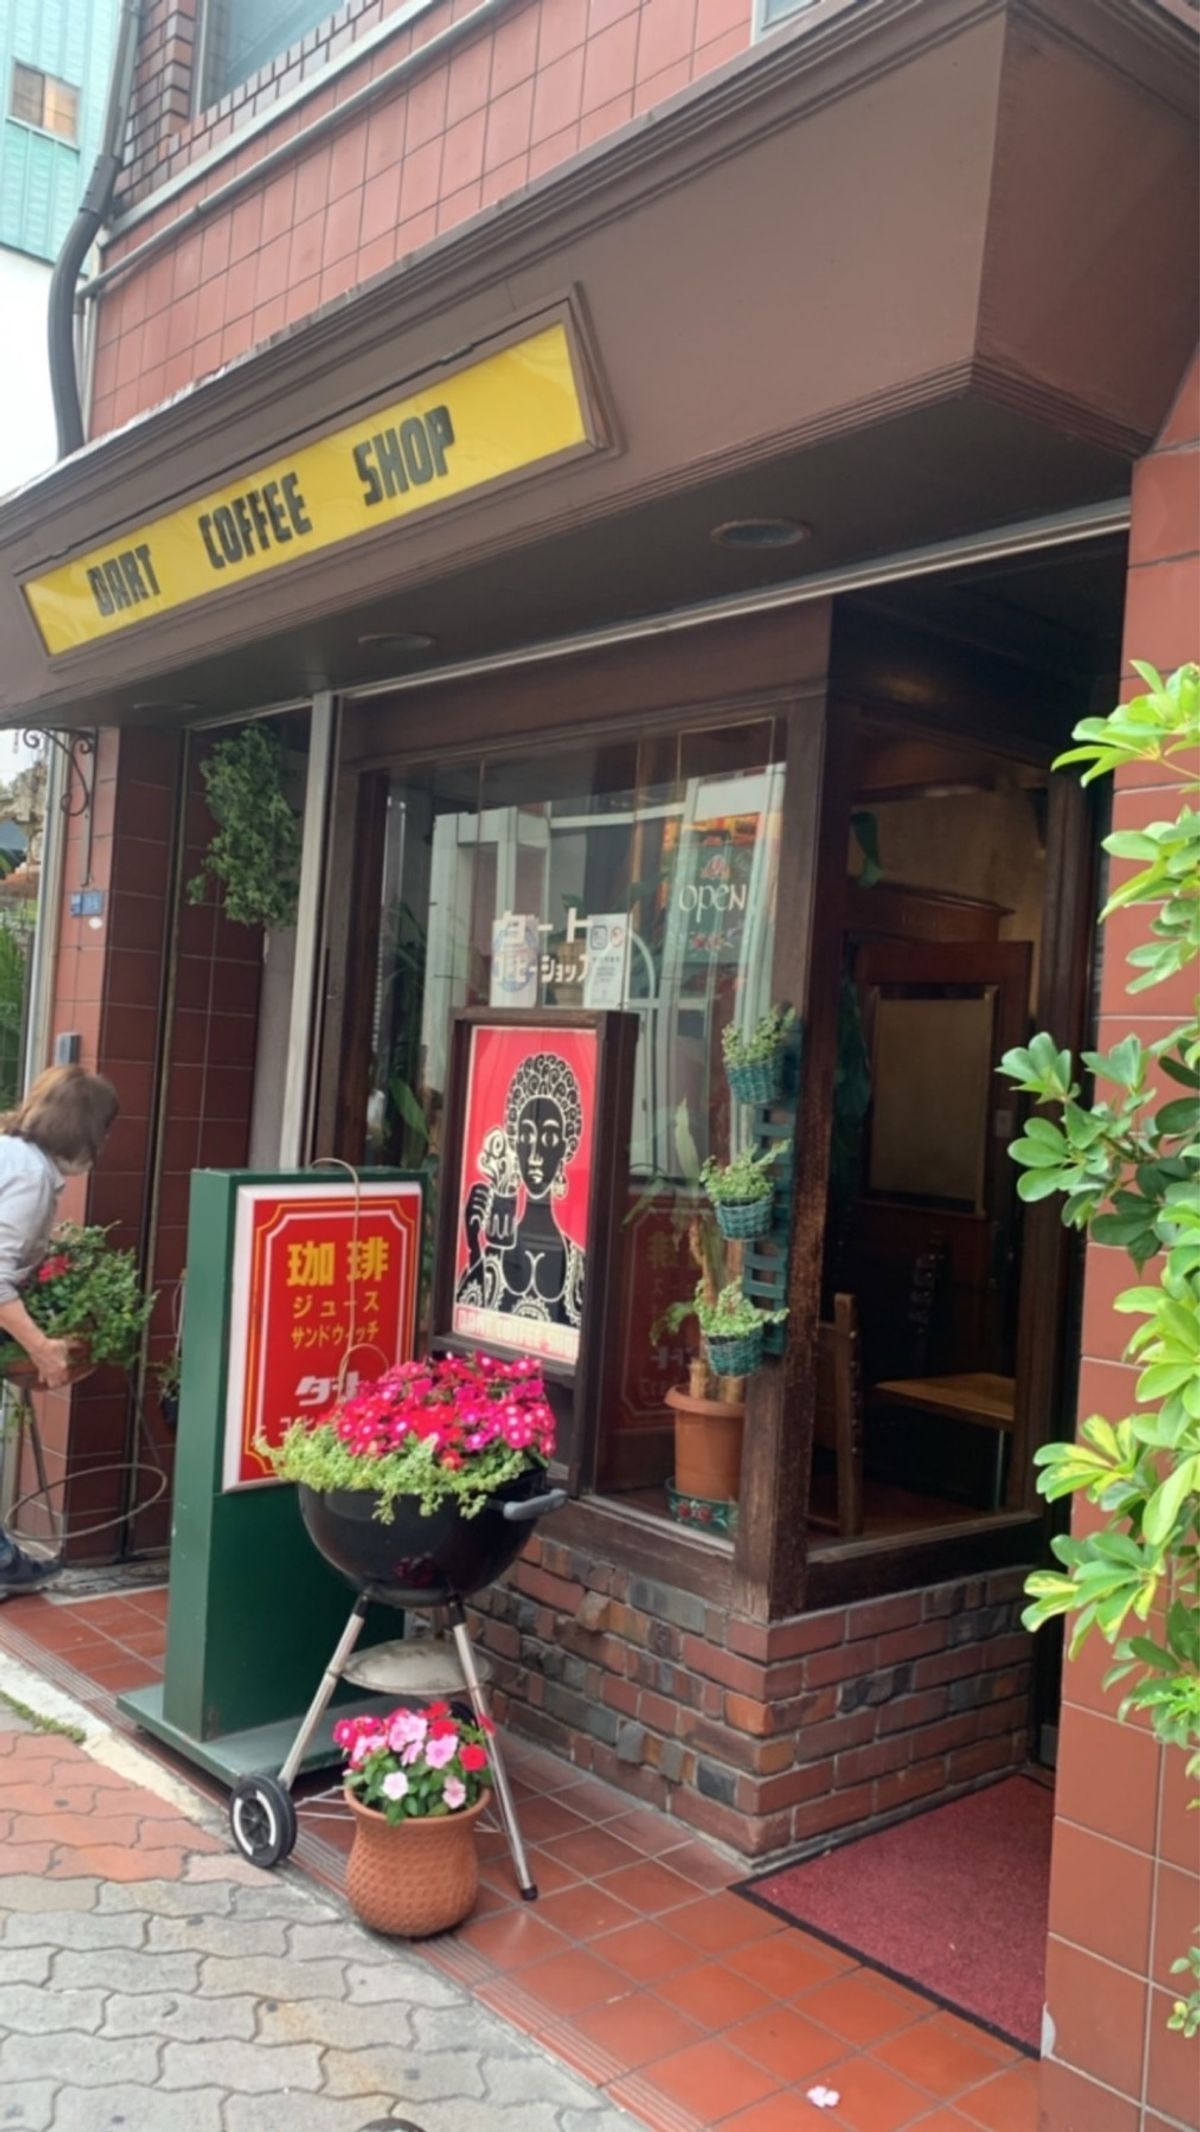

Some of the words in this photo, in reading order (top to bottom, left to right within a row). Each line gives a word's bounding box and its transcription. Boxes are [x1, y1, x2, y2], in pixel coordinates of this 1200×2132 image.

[87, 543, 161, 618] DART
[198, 471, 313, 570] COFFEE
[353, 405, 455, 507] SHOP
[286, 1236, 389, 1286] 珈琲
[293, 1290, 379, 1319] ジュース
